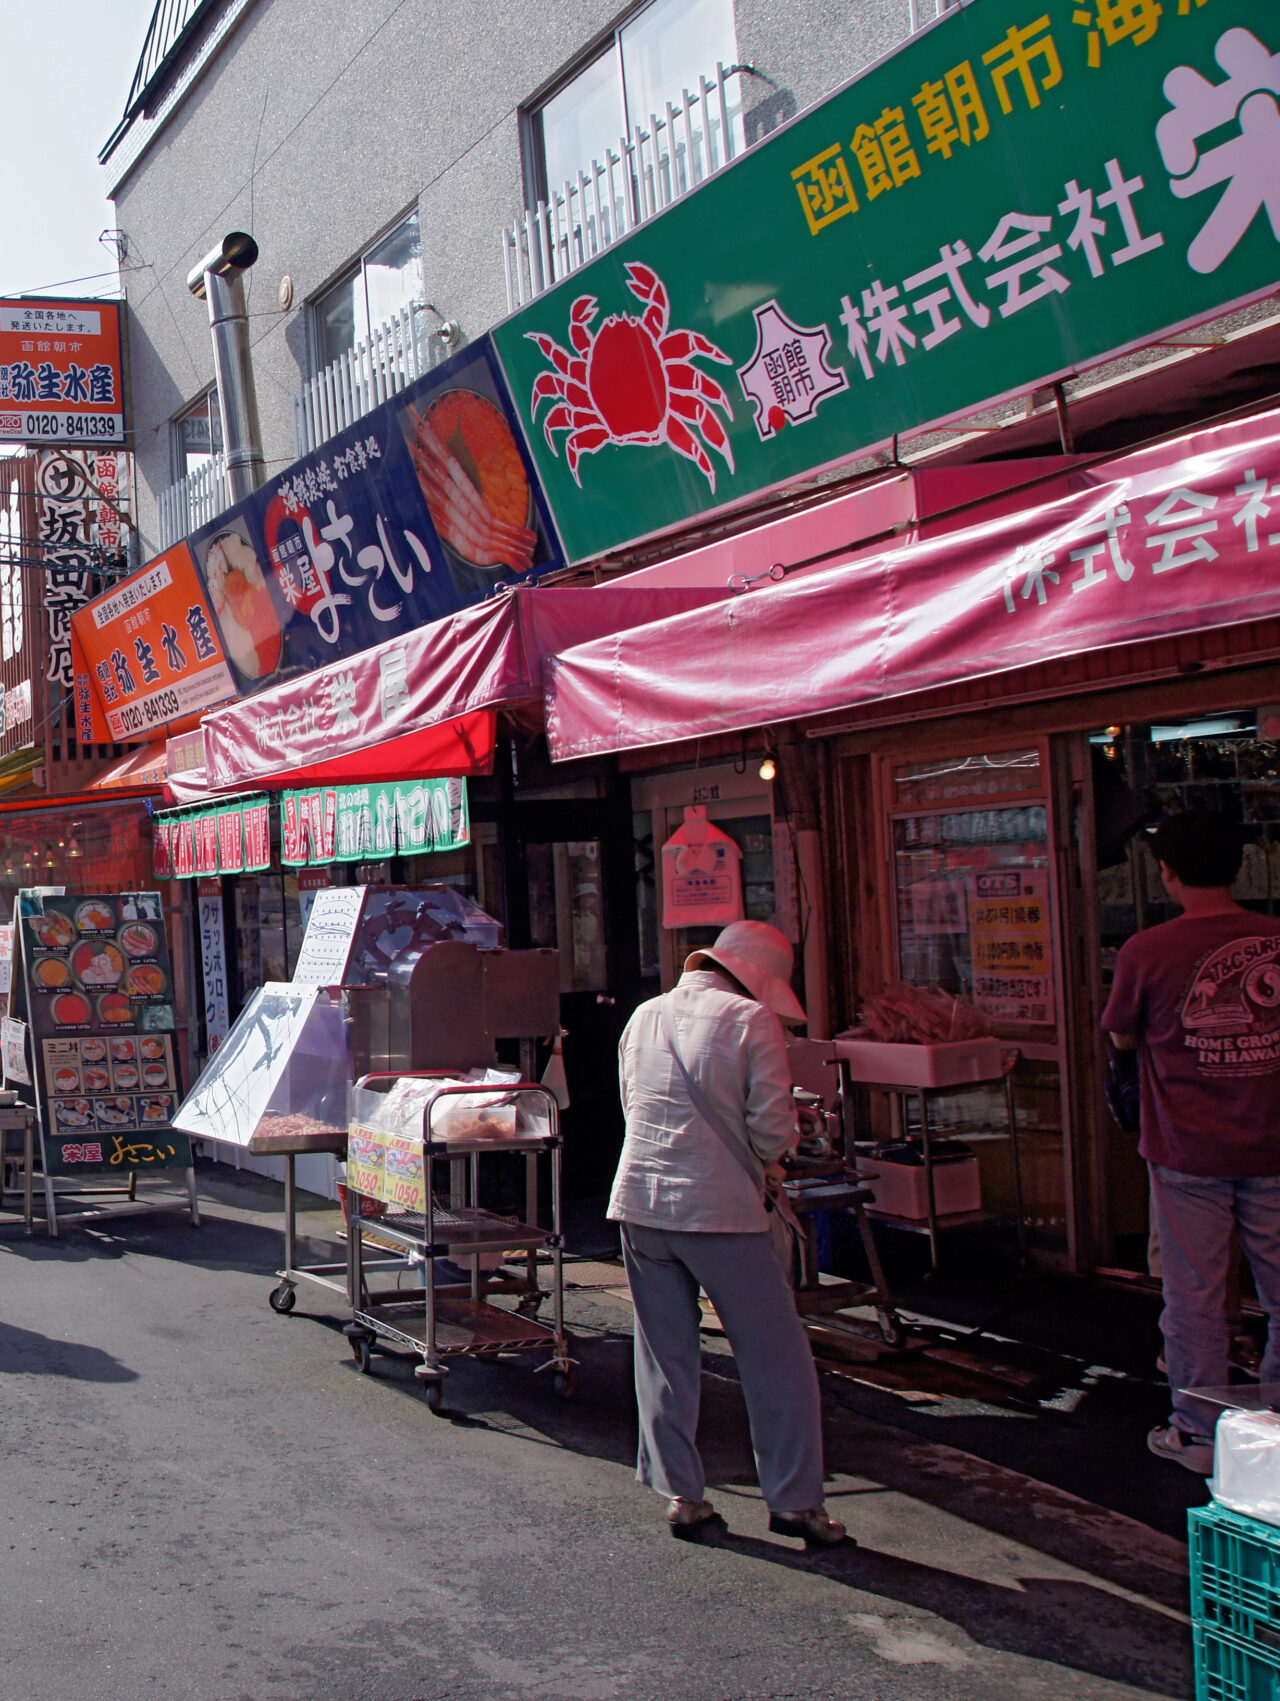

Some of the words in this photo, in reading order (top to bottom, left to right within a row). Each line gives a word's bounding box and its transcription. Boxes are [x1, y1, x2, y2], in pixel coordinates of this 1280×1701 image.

[790, 0, 1208, 236] 函館朝市海
[838, 158, 1166, 380] 株式会社
[11, 321, 91, 333] 発送いたします。
[24, 310, 77, 320] 全国各地へ
[21, 340, 83, 352] 函館朝市
[761, 338, 807, 380] 函館
[11, 362, 115, 403] 弥生水産
[96, 457, 120, 548] 函館朝市
[279, 554, 321, 605] 栄屋
[302, 500, 432, 643] よさこい
[111, 605, 217, 694] 弥生水産
[78, 688, 94, 741] 弥生水産
[287, 802, 299, 857] ラーメン
[978, 874, 1017, 888] OTS
[202, 902, 216, 1023] クラシック
[210, 902, 224, 998] サッポロ
[48, 1041, 79, 1053] ミニ丼
[1184, 1034, 1234, 1050] HOME
[1198, 1050, 1221, 1064] IN
[62, 1143, 103, 1163] 栄屋
[110, 1136, 177, 1165] よさこい
[356, 1170, 379, 1192] 1050
[394, 1183, 419, 1206] 1050
